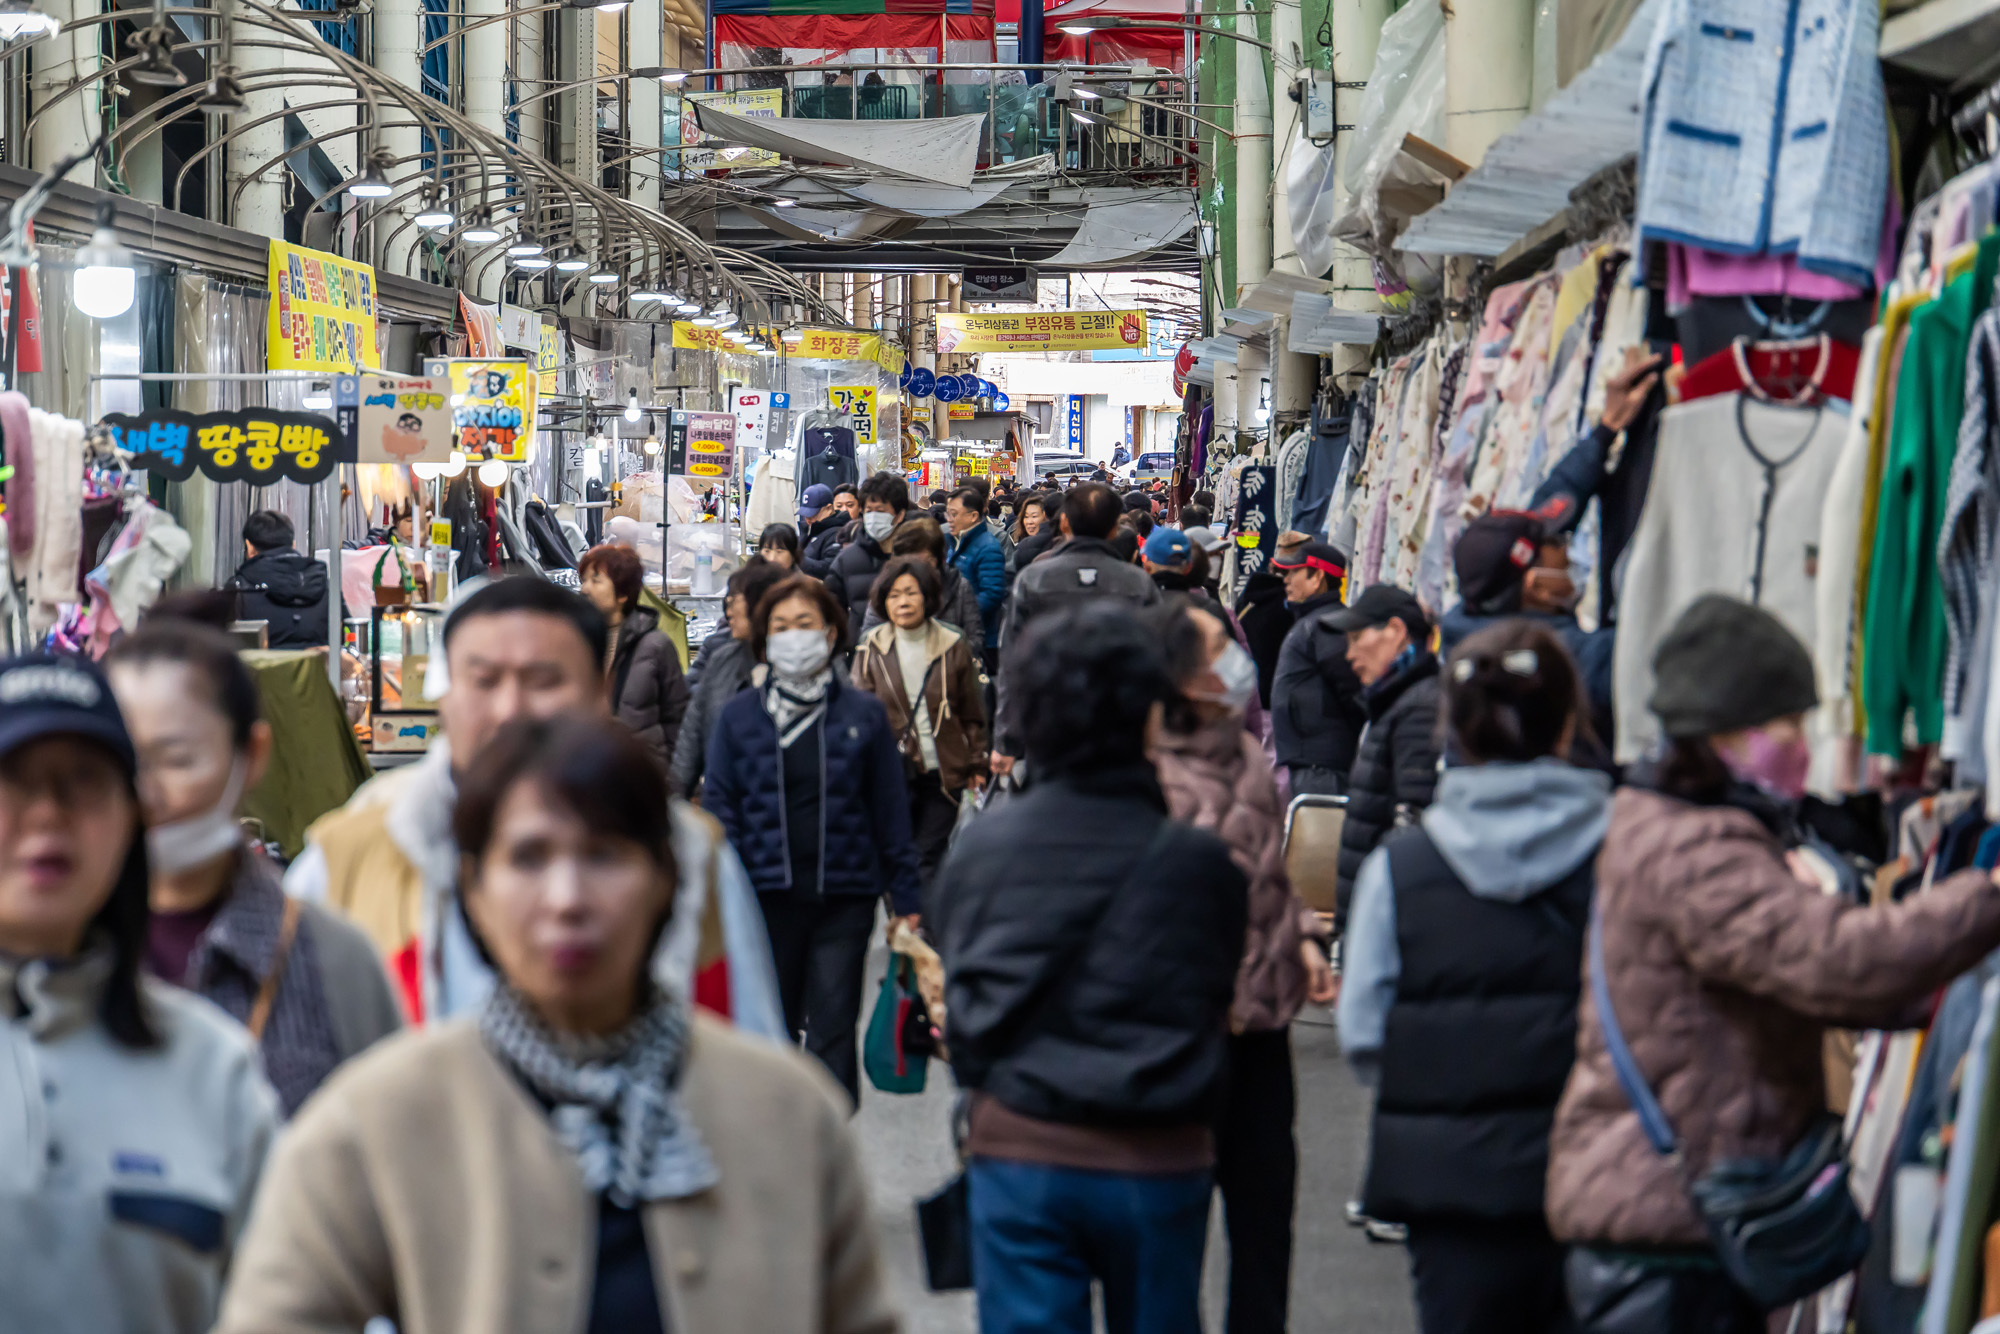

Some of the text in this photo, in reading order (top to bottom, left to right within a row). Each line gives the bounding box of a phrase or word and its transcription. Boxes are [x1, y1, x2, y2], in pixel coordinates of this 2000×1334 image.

[975, 274, 1015, 283] 만남의 장소
[1016, 289, 1021, 297] 2
[965, 319, 1020, 330] 온누리상품권
[1025, 315, 1076, 331] 부정유통
[1080, 314, 1115, 330] 근절!!
[292, 311, 311, 361] 칼국수
[810, 335, 861, 356] 화장품
[690, 419, 713, 430] 생활의
[713, 418, 733, 431] 달인
[197, 420, 330, 471] 땅콩빵
[802, 494, 809, 504] C
